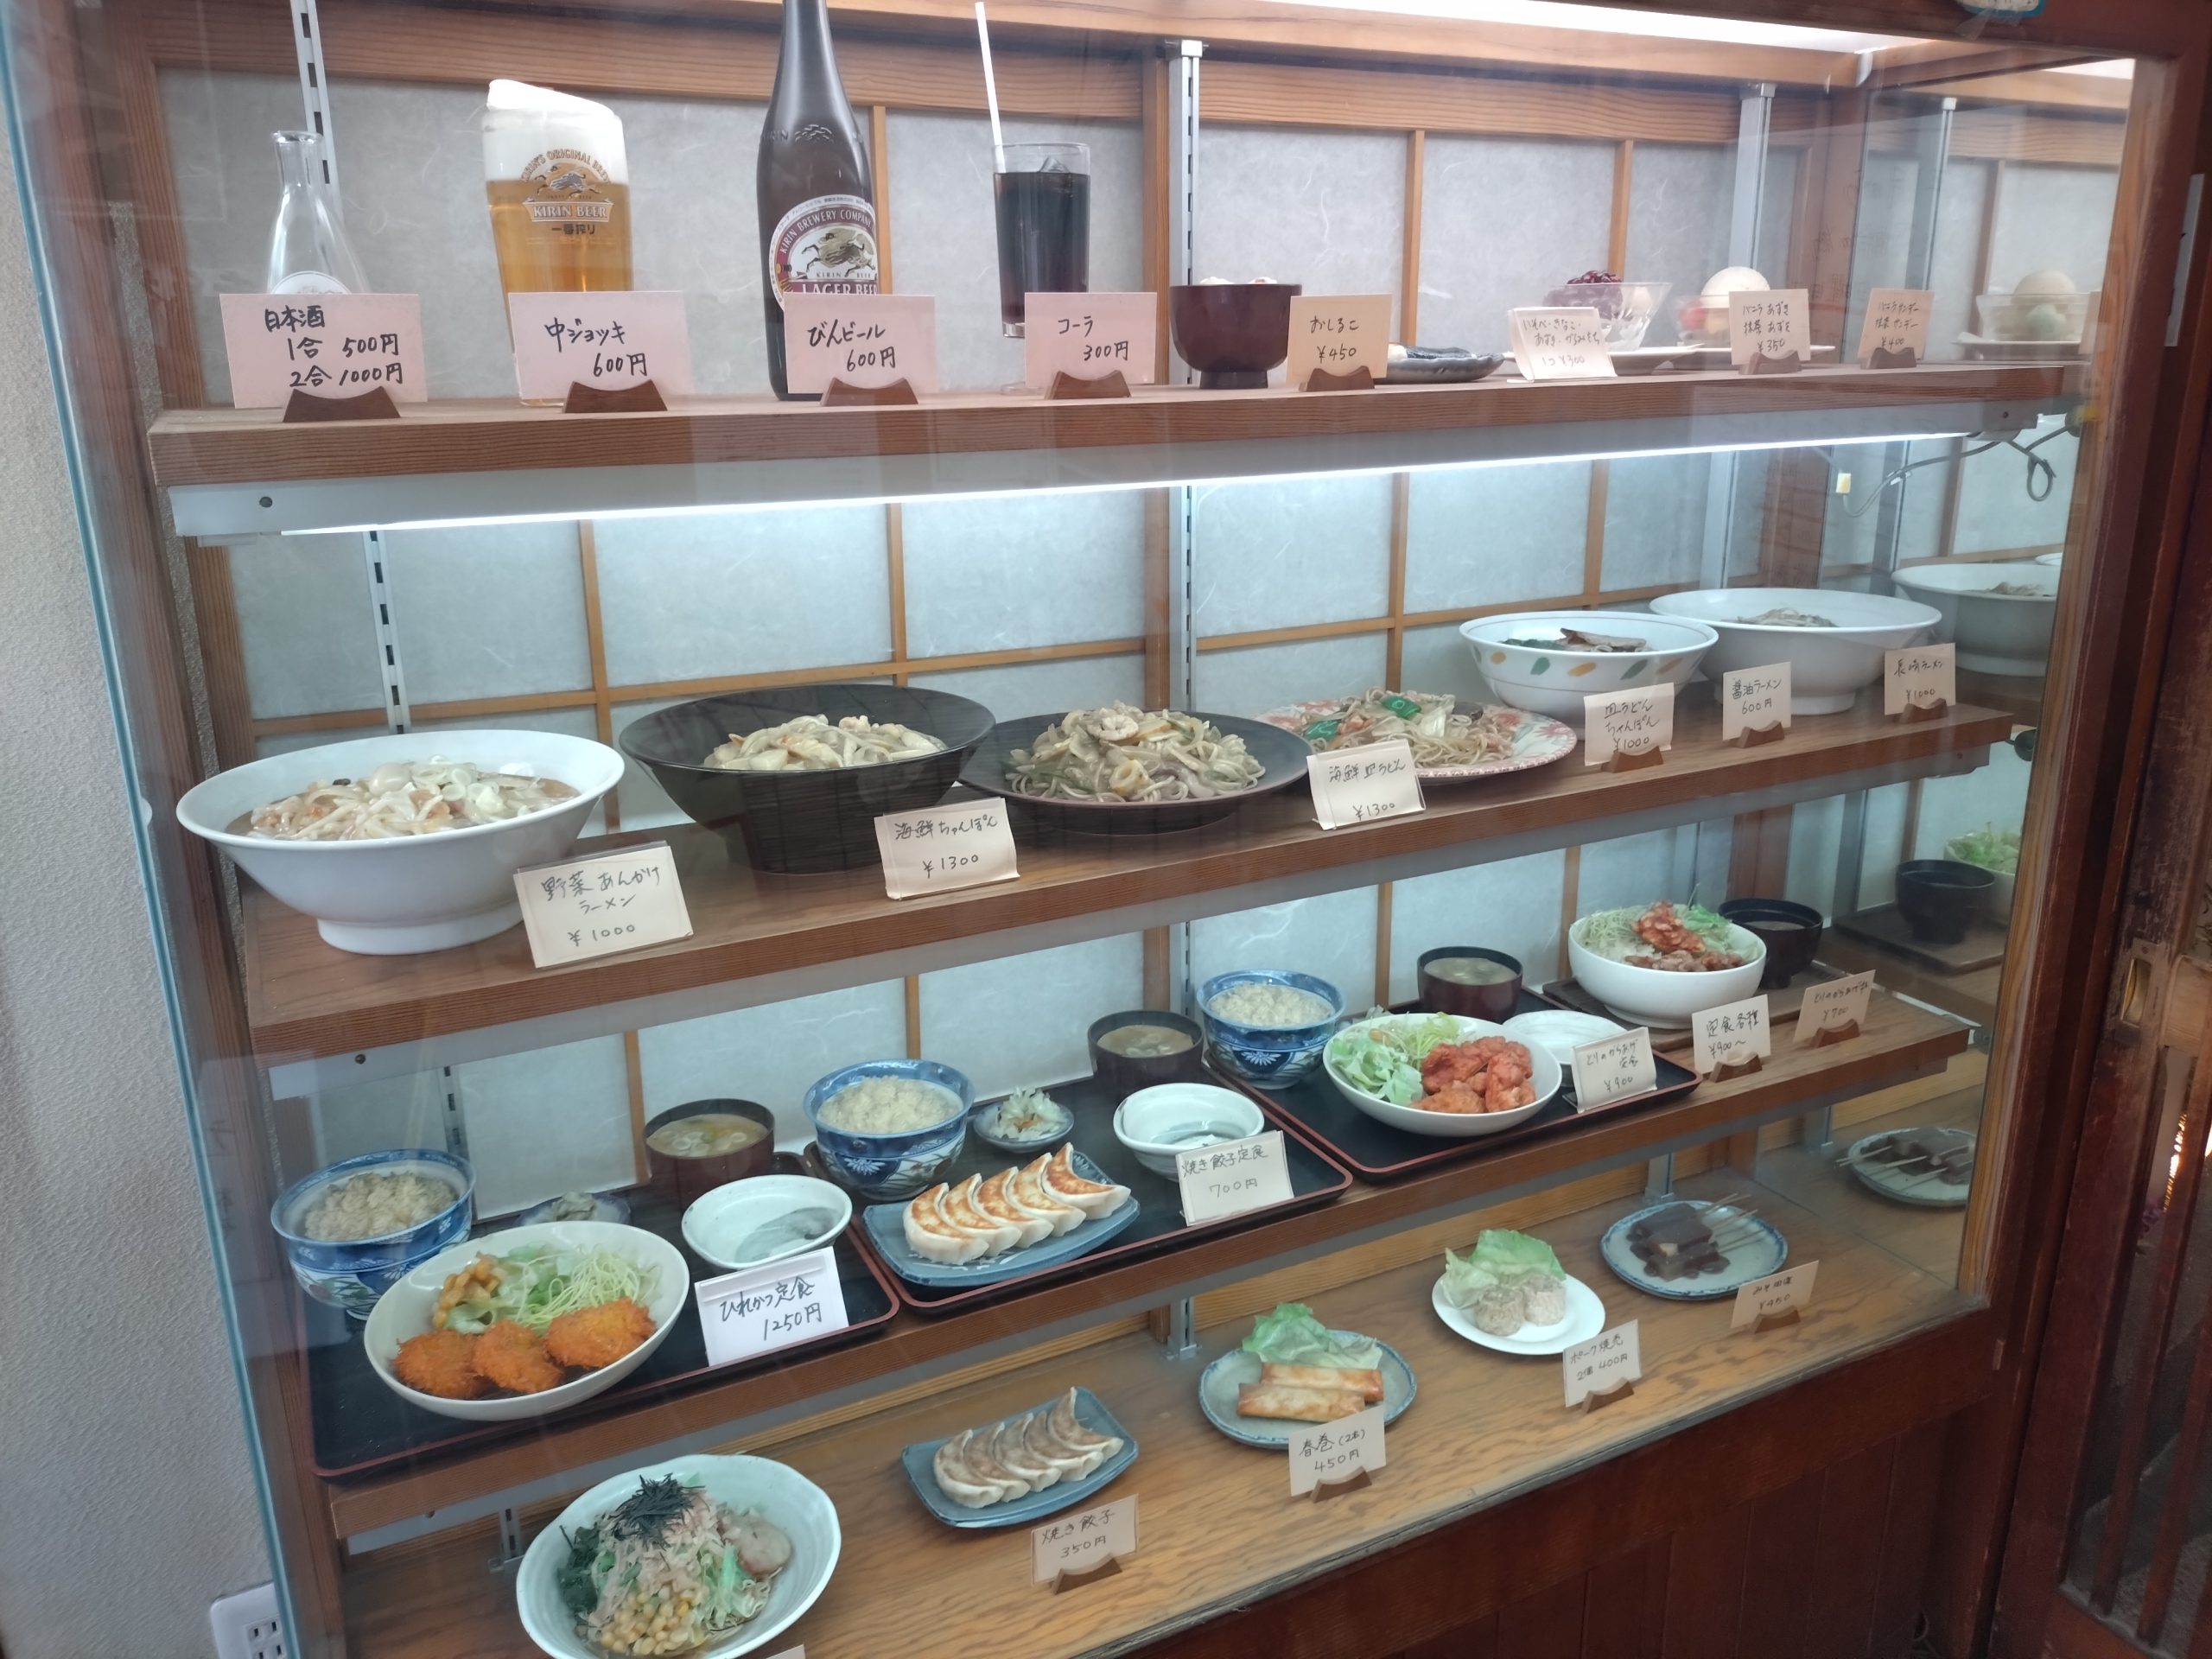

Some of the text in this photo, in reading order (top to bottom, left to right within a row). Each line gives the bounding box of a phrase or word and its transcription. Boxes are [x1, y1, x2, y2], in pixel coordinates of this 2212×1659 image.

[546, 148, 591, 165] ORIGINAL
[533, 206, 607, 218] KIRIN BEER
[551, 224, 595, 235] 一番搾り
[779, 228, 798, 254] KIRIN
[797, 210, 836, 232] BREWERY
[264, 305, 325, 333] 日本酒
[1058, 315, 1093, 337] コーラ
[1310, 315, 1359, 334] おしるこ
[544, 317, 625, 353] 中ジョッキ
[807, 319, 886, 347] びんビール
[288, 334, 399, 360] 1合 500円
[1084, 340, 1128, 361] 300円
[1317, 343, 1357, 364] ¥450
[1758, 338, 1785, 353] ¥350
[593, 353, 647, 377] 600円
[847, 346, 895, 372] 600円
[289, 362, 403, 387] 2合 1000円
[1732, 677, 1782, 700] 醤油ラーメン
[1604, 699, 1653, 719] 皿うどん
[1742, 698, 1772, 715] 600円
[1605, 715, 1660, 736] ちゃんぽん
[1329, 759, 1406, 783] 海鮮皿うどん
[1352, 803, 1395, 821] ¥1300
[894, 814, 998, 841] 海鮮ちゃんぽん
[922, 854, 979, 879] ¥1300
[580, 893, 636, 915] ラーメン
[568, 925, 636, 947] ¥1000
[1604, 1076, 1633, 1092] ¥900
[1181, 1144, 1269, 1178] 焼き餃子定食
[1209, 1178, 1258, 1198] 700円
[720, 1275, 815, 1321] ひれかつ定食
[764, 1302, 822, 1341] 1250円
[1570, 1333, 1624, 1364] ポーク焼売
[1599, 1353, 1628, 1370] 400円
[1314, 1448, 1359, 1472] 450円
[1042, 1509, 1116, 1545] 焼き餃子
[1060, 1535, 1106, 1558] 350円
